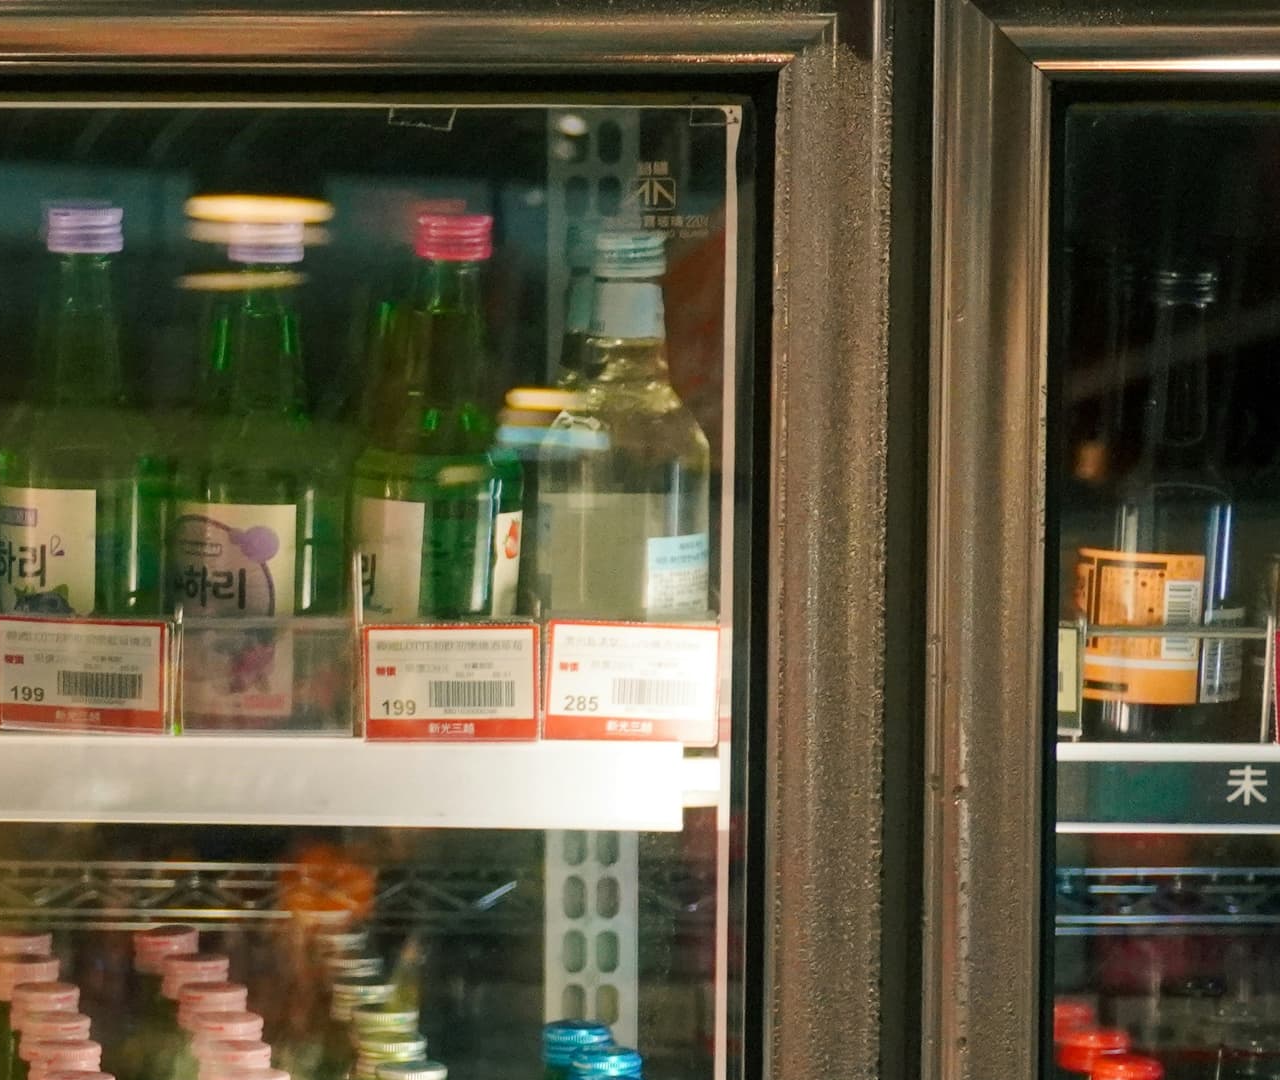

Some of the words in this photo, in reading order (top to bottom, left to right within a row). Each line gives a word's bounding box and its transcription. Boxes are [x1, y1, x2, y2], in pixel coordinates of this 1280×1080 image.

[9, 685, 45, 703] 199
[381, 699, 417, 717] 199
[563, 695, 600, 712] 285
[427, 722, 476, 736] 新光三越
[605, 720, 654, 734] 新光三越
[1226, 764, 1269, 806] 未
